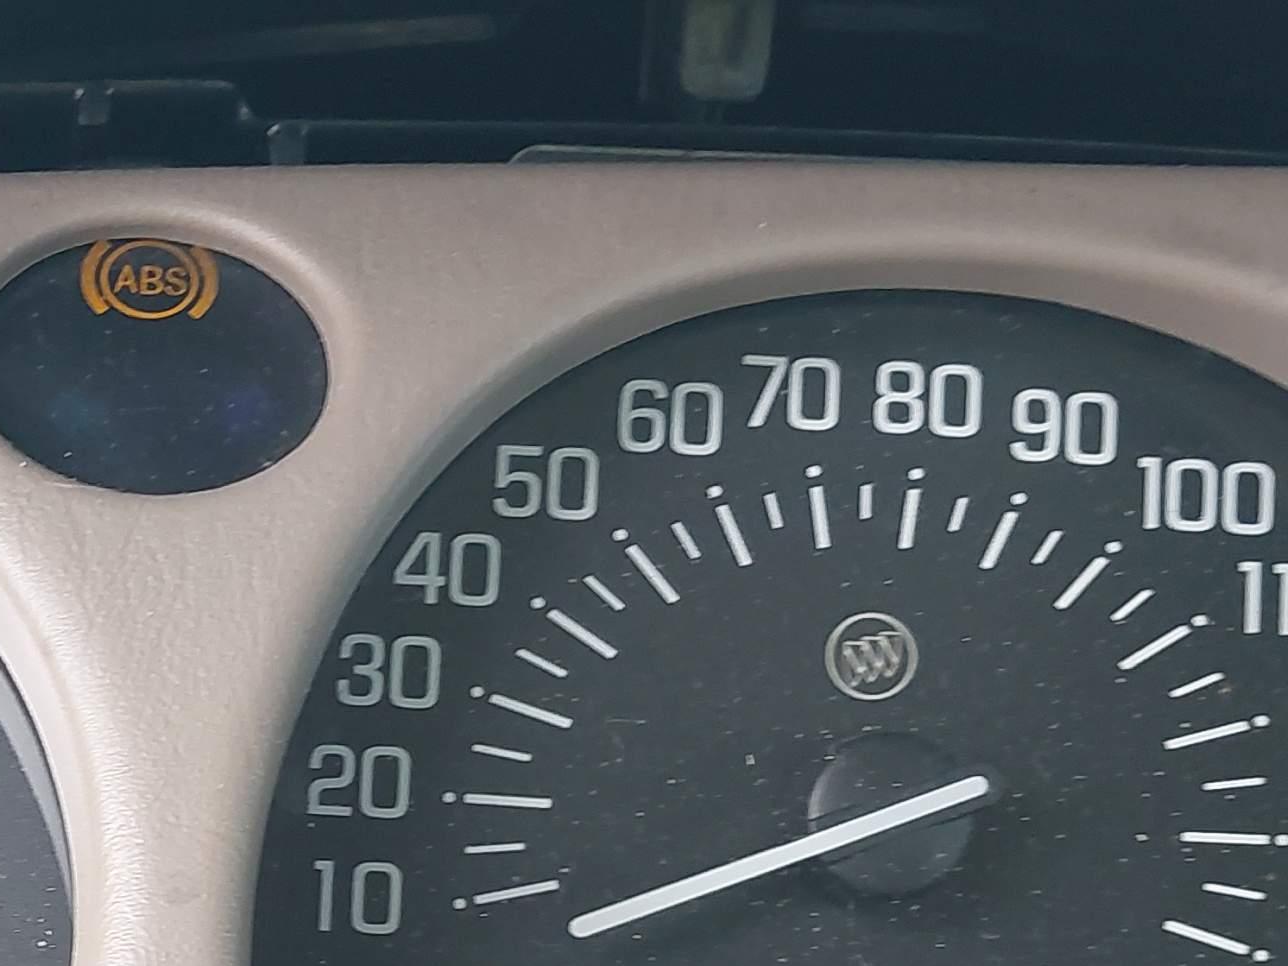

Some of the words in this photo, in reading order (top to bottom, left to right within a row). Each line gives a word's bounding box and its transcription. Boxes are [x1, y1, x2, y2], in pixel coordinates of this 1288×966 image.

[114, 264, 188, 297] ABS
[617, 379, 724, 455] 60
[741, 354, 841, 431] 70
[872, 360, 983, 438] 80
[1009, 388, 1119, 465] 90
[492, 444, 600, 521] 50
[1136, 456, 1275, 536] 100
[393, 531, 502, 607] 40
[336, 633, 442, 709] 30
[306, 743, 411, 819] 20
[313, 859, 403, 935] 10
